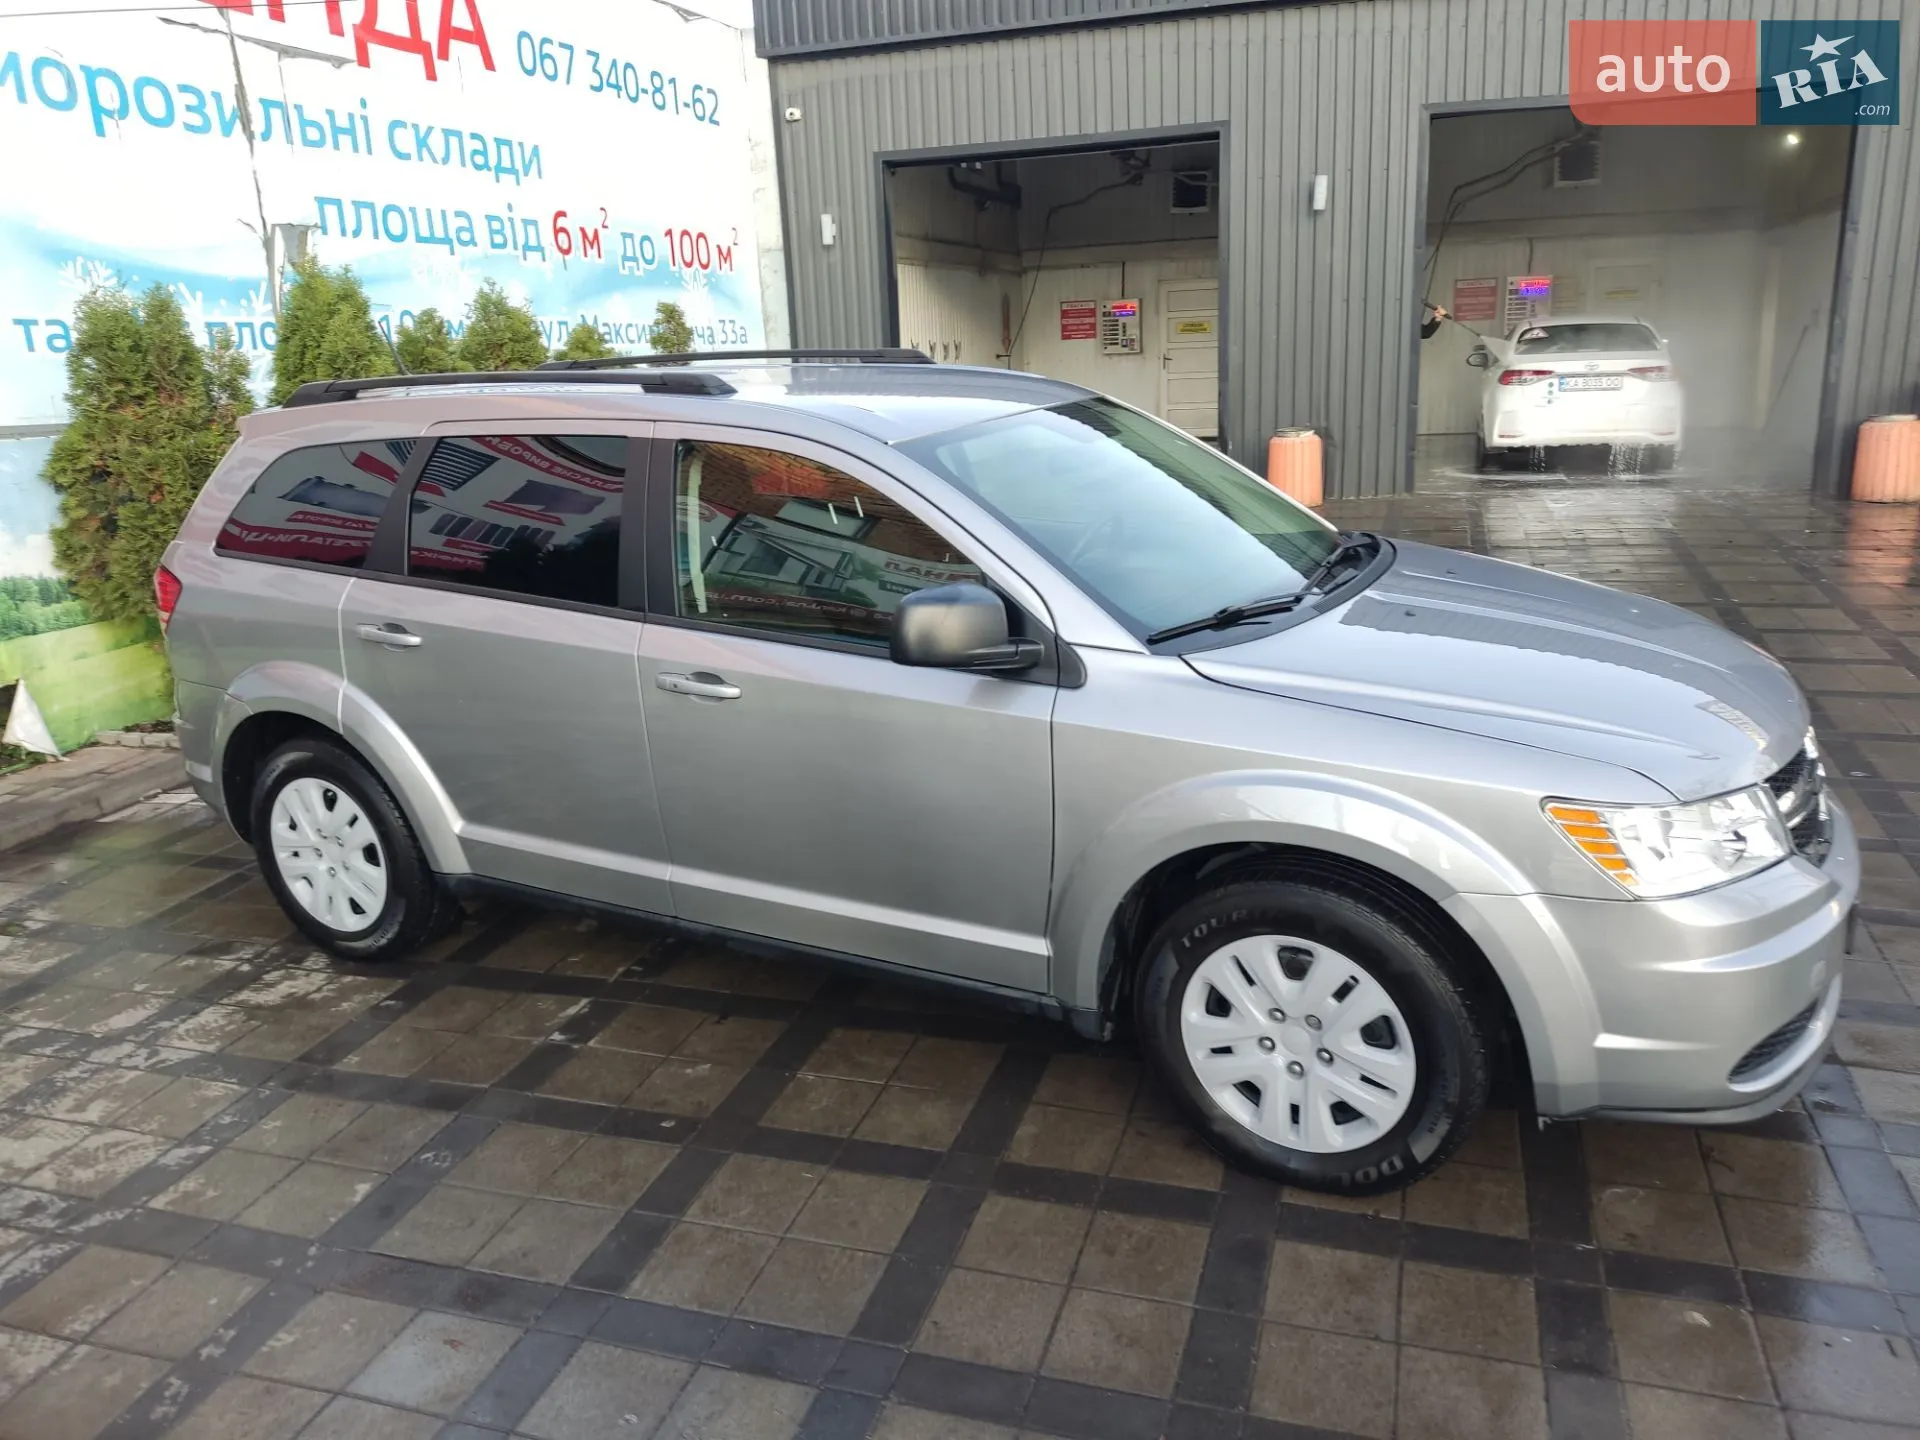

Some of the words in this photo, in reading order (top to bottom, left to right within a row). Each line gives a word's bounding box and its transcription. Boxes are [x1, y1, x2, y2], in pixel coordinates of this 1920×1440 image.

[516, 30, 575, 85] 067
[586, 49, 720, 126] 340-81-62
[387, 119, 543, 186] склади
[314, 195, 478, 256] площа
[485, 202, 546, 262] від
[553, 210, 573, 256] 6
[620, 232, 656, 272] до
[664, 228, 711, 270] 100
[718, 319, 749, 345] 33а
